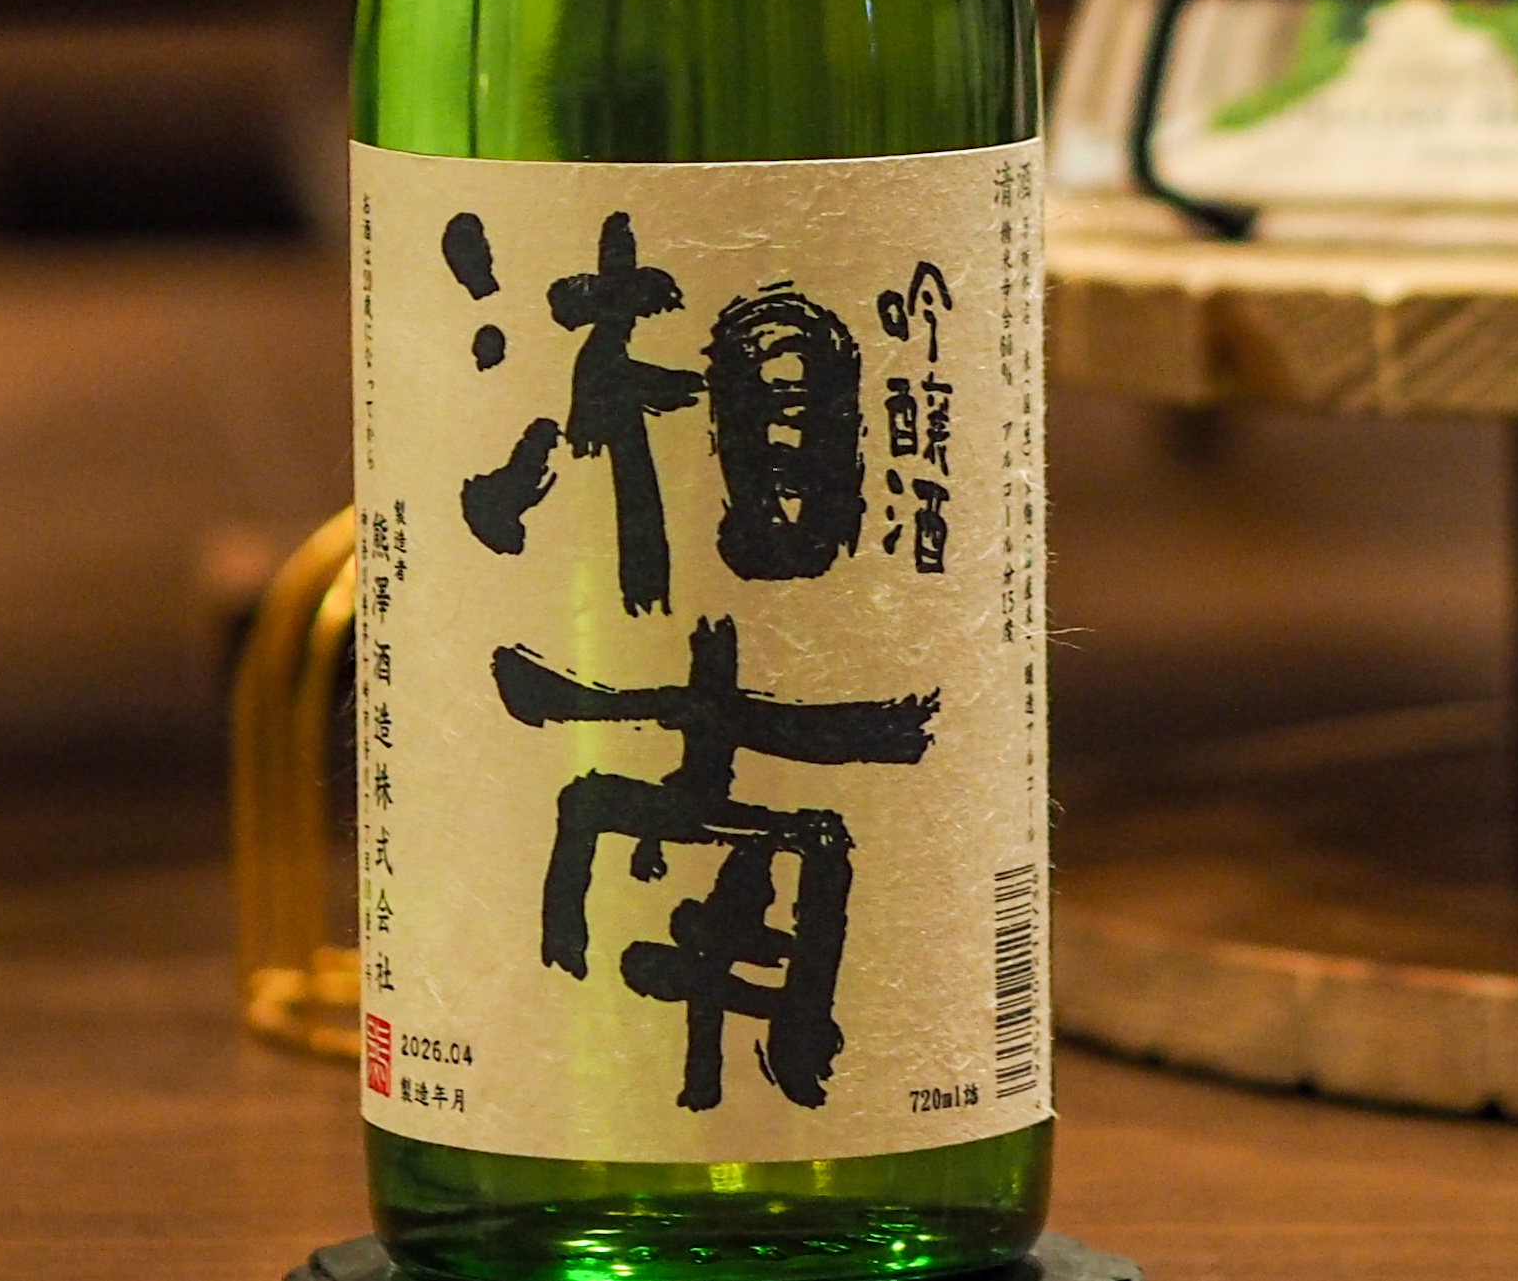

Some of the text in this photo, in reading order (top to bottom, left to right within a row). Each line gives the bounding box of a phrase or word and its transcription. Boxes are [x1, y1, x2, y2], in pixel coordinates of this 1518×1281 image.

[400, 1033, 474, 1067] 2026.04
[400, 1075, 466, 1113] 製造年月
